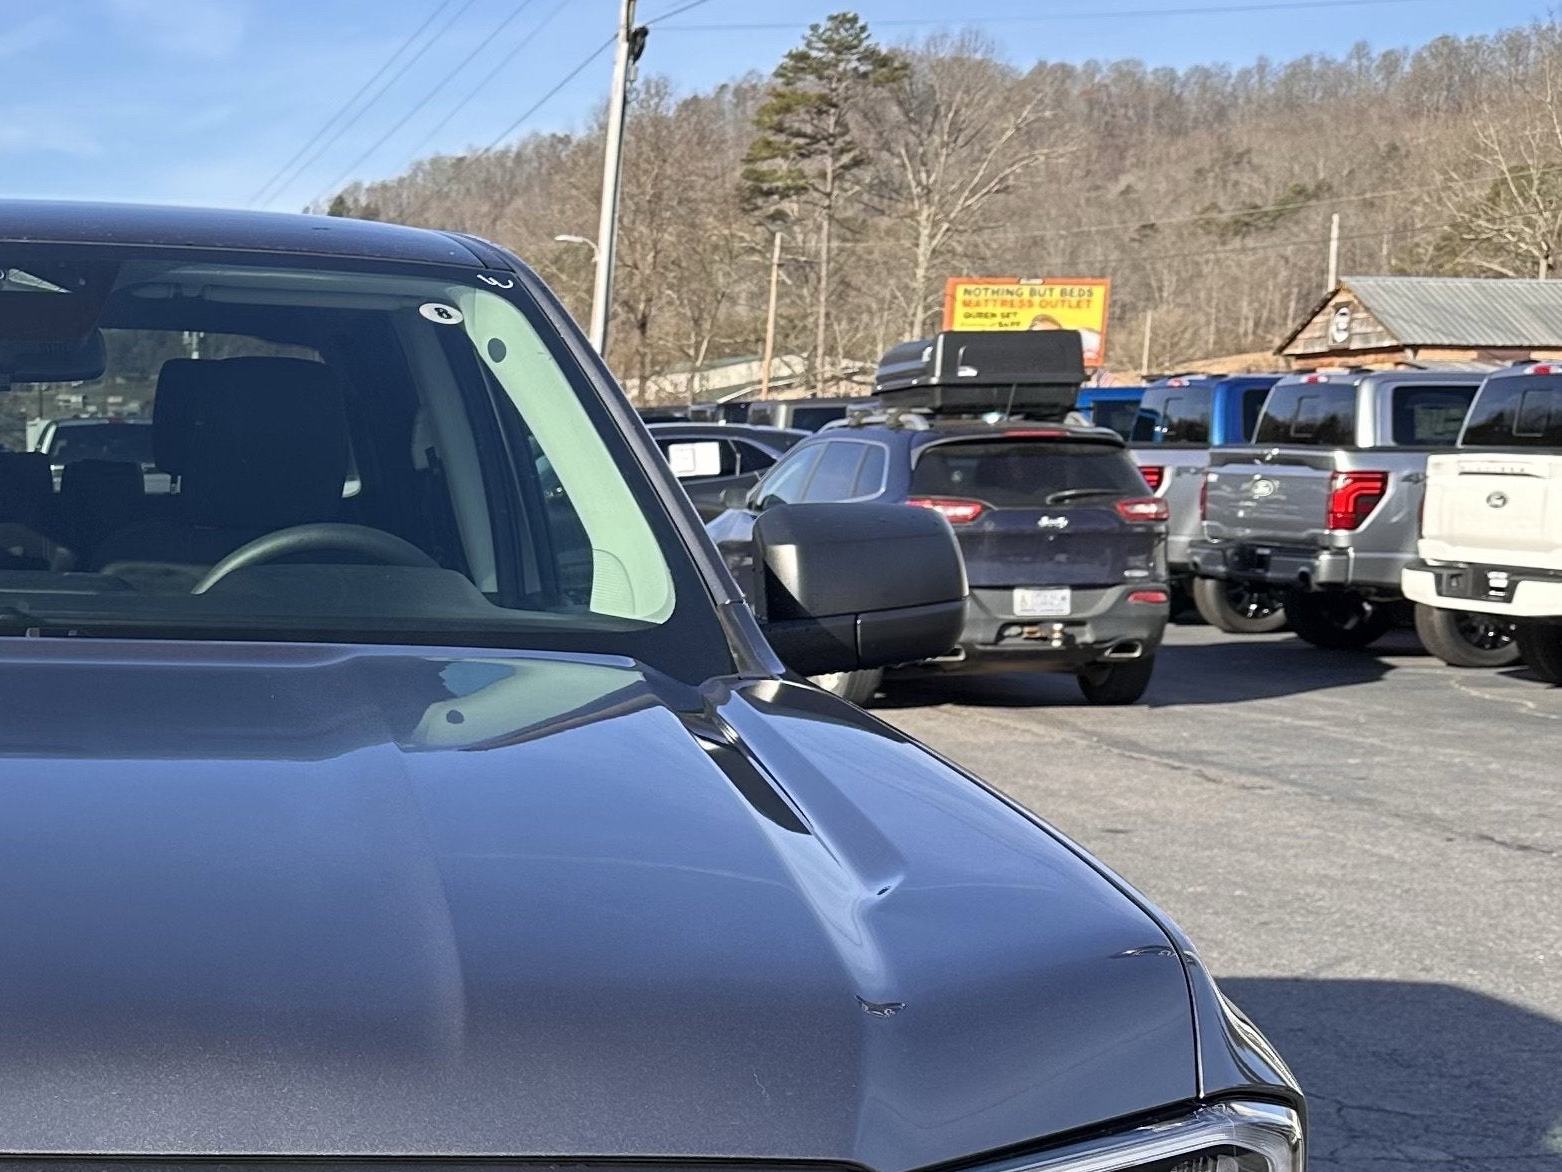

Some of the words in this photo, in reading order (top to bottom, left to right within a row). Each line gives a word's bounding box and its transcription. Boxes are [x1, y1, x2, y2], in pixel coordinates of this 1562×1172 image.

[963, 288, 1023, 297] NOTHING
[1029, 288, 1055, 297] BUT
[1060, 288, 1094, 297] BEDS
[962, 299, 1034, 308] MATTRESS
[1039, 299, 1092, 308] OUTLET
